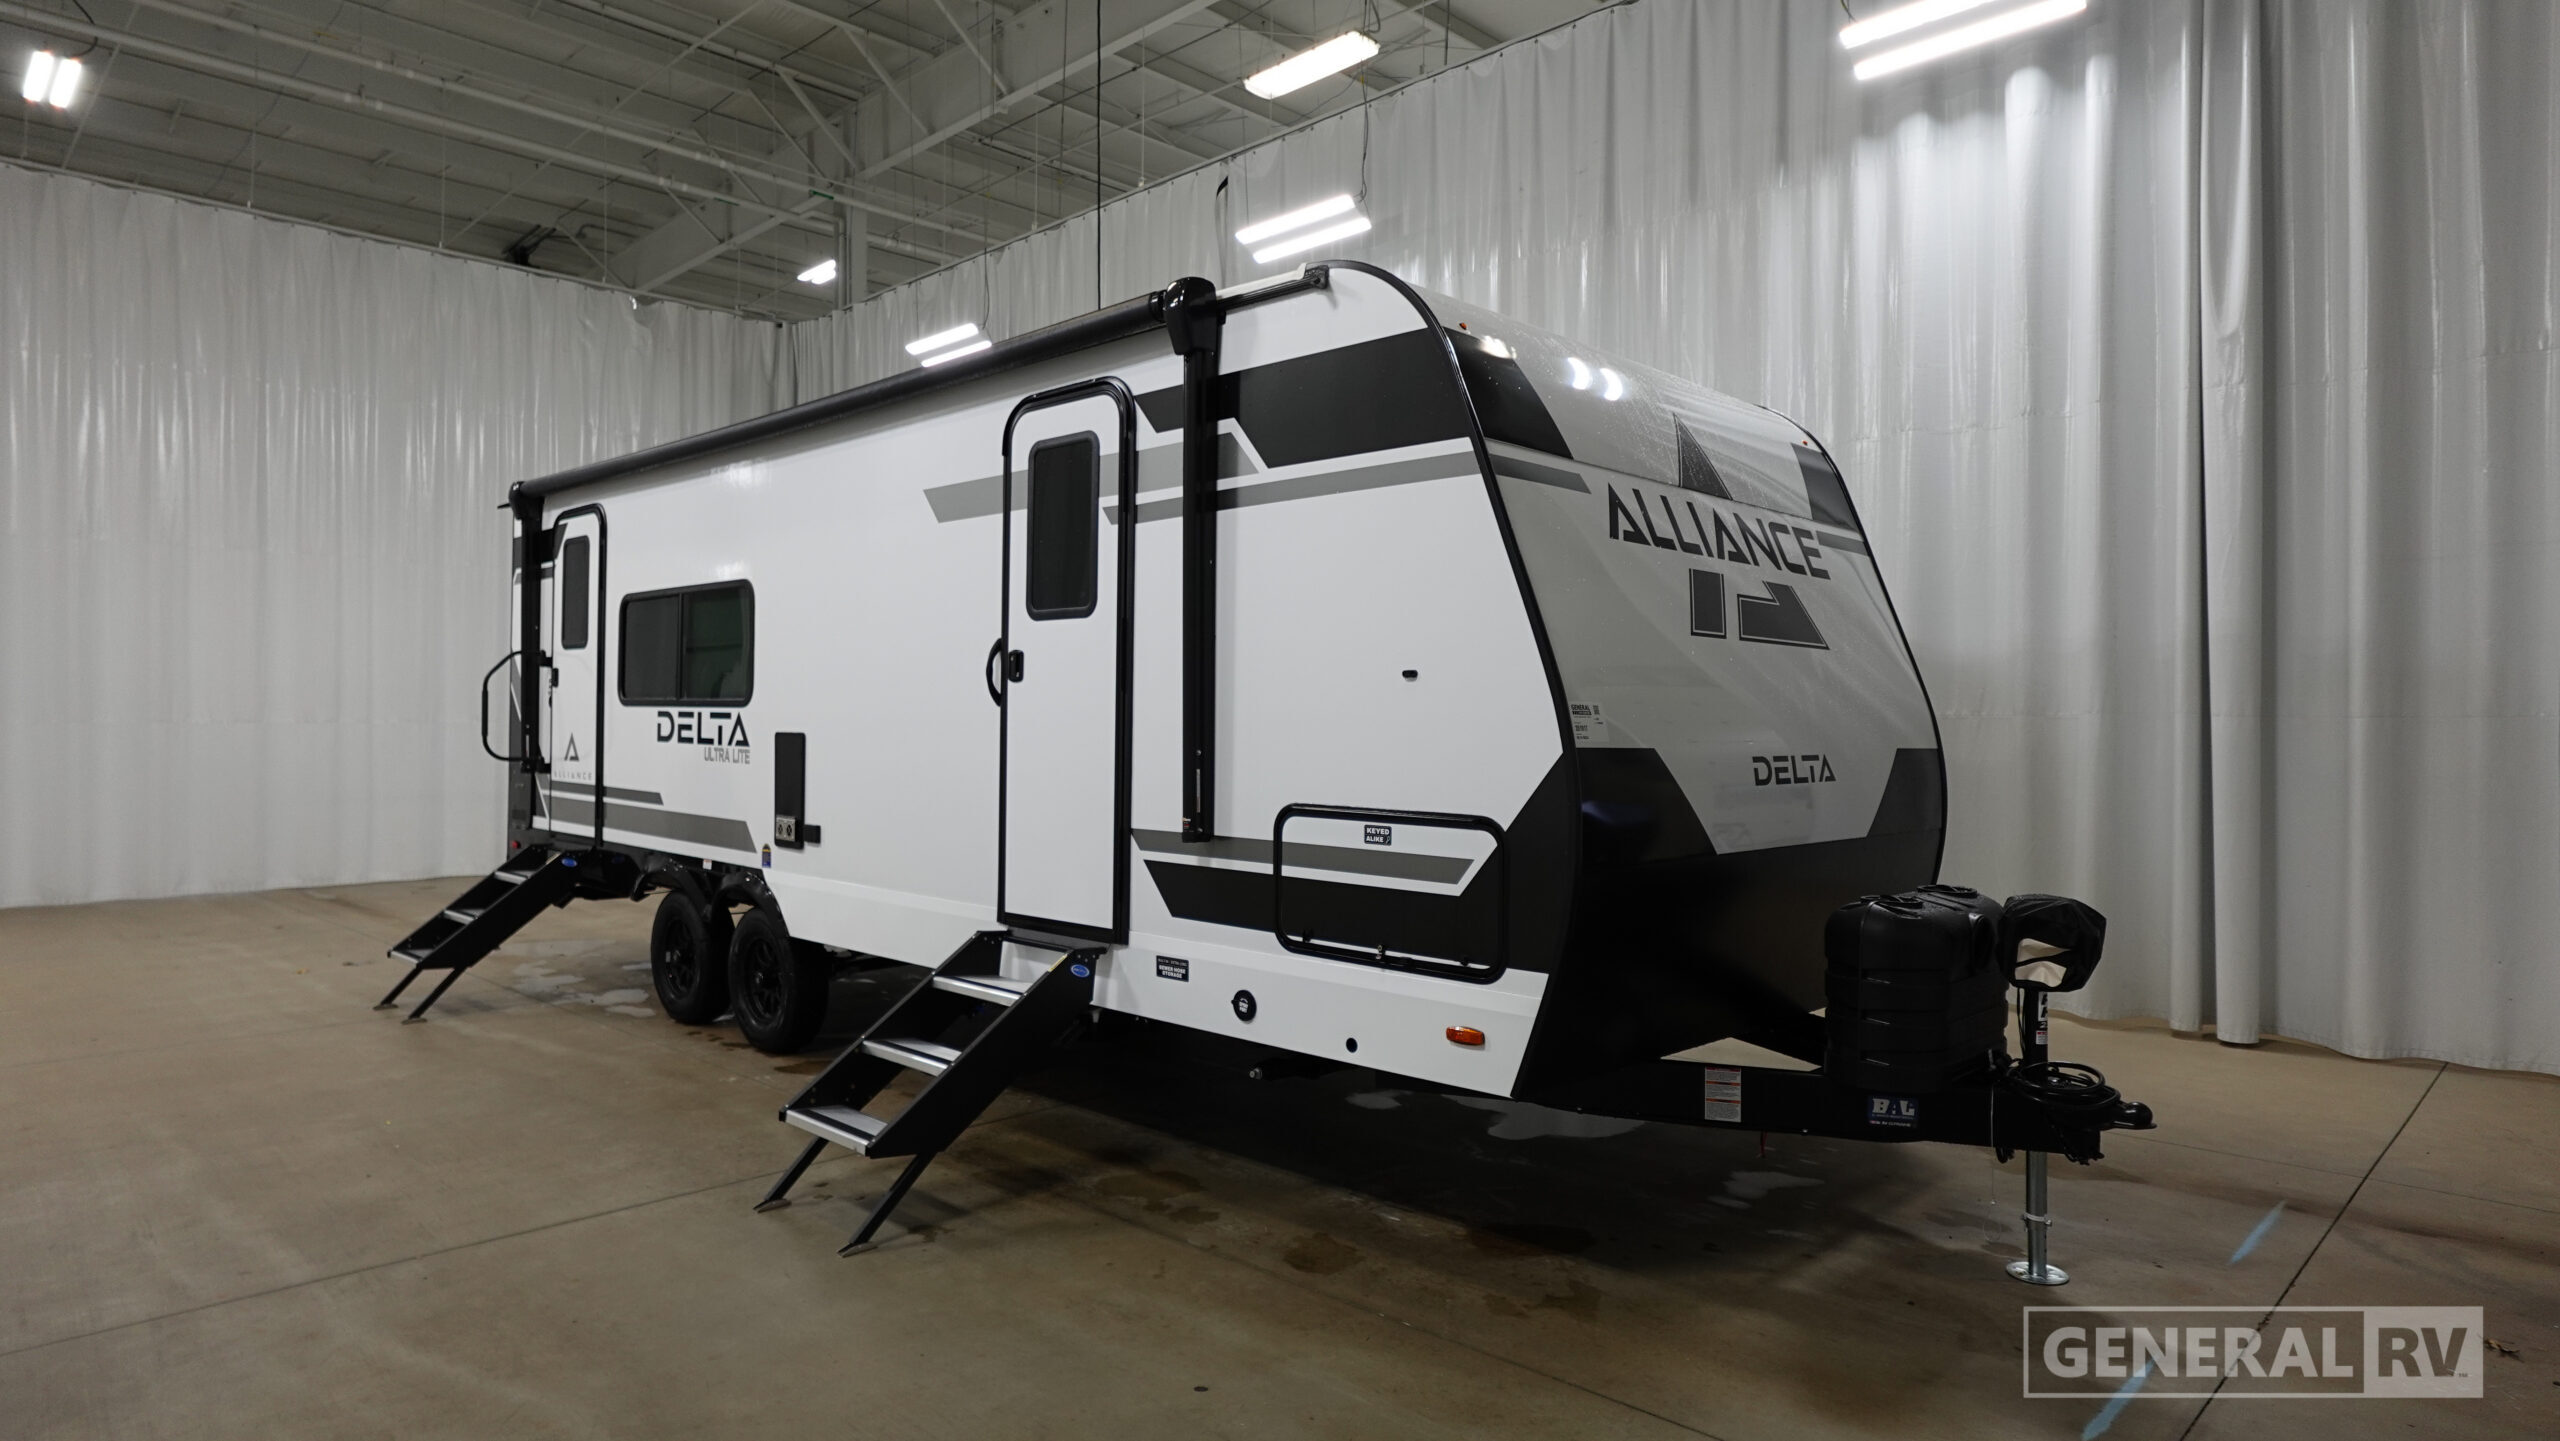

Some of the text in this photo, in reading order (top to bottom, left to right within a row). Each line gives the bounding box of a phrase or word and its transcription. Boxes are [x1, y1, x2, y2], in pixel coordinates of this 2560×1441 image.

[1608, 482, 1831, 580] ALLIANCE
[657, 711, 750, 747] DELTA
[704, 747, 750, 764] ULTRA LITE
[1752, 754, 1836, 786] DELTA
[1366, 827, 1390, 835] KEYED
[1366, 835, 1384, 843] ALIKE
